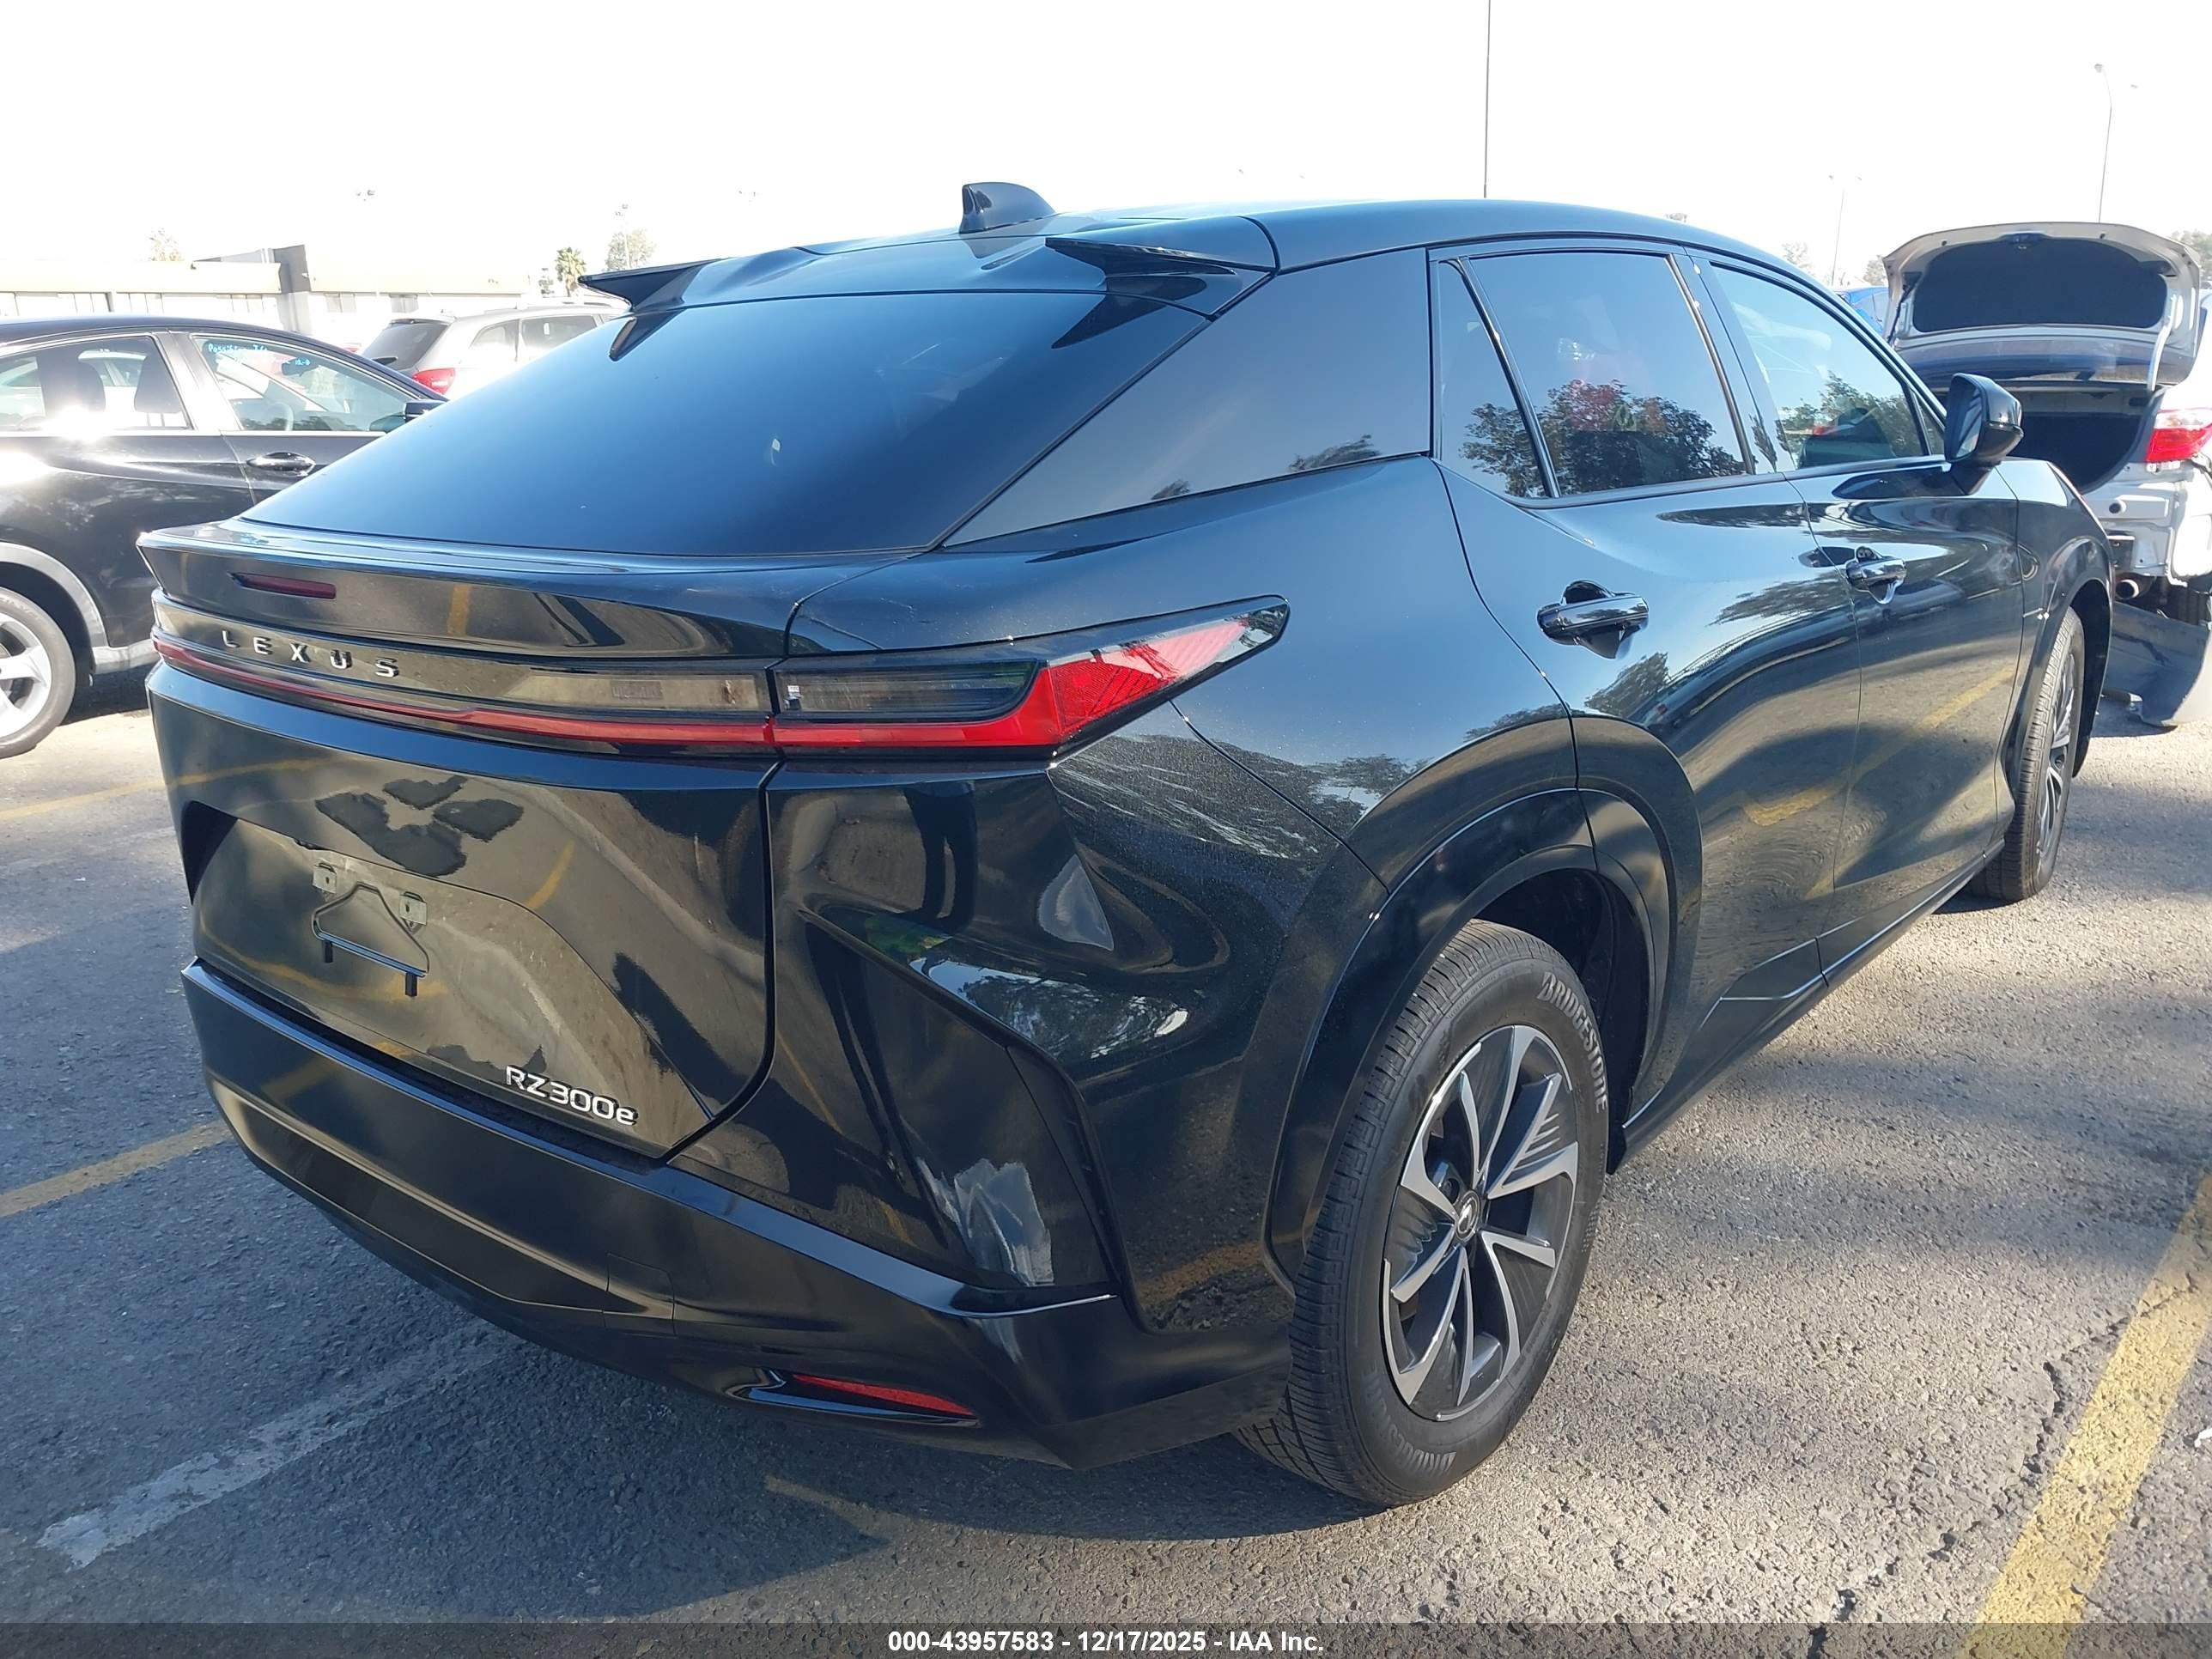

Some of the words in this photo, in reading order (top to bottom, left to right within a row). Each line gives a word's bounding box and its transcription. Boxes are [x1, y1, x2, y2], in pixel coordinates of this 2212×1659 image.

[221, 629, 399, 678] LEXUS
[1537, 972, 1608, 1114] BRIDGESTONE
[505, 1064, 639, 1126] RZ300e
